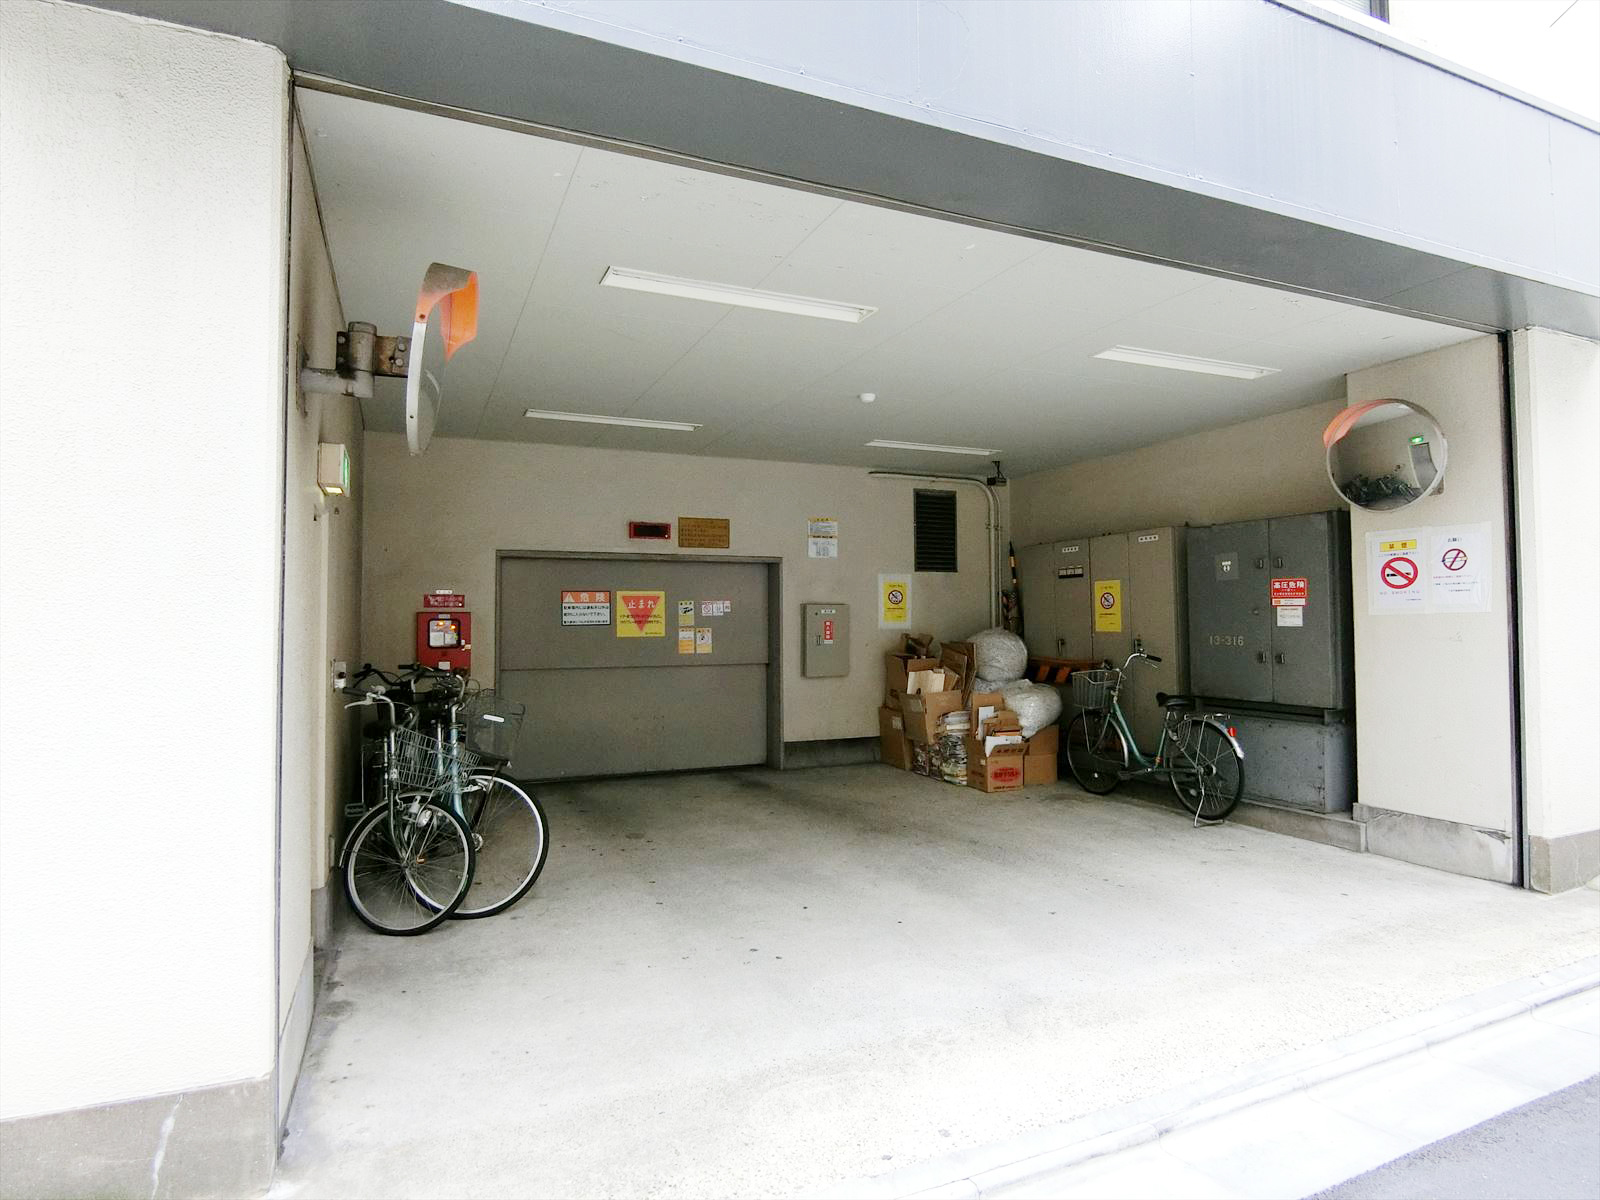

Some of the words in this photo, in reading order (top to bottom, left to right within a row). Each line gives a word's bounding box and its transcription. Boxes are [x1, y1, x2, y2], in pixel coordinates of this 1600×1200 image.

[1273, 581, 1305, 589] 高圧危険
[580, 592, 608, 602] 危険
[628, 599, 655, 609] 止まれ
[1209, 635, 1244, 646] 13-316
